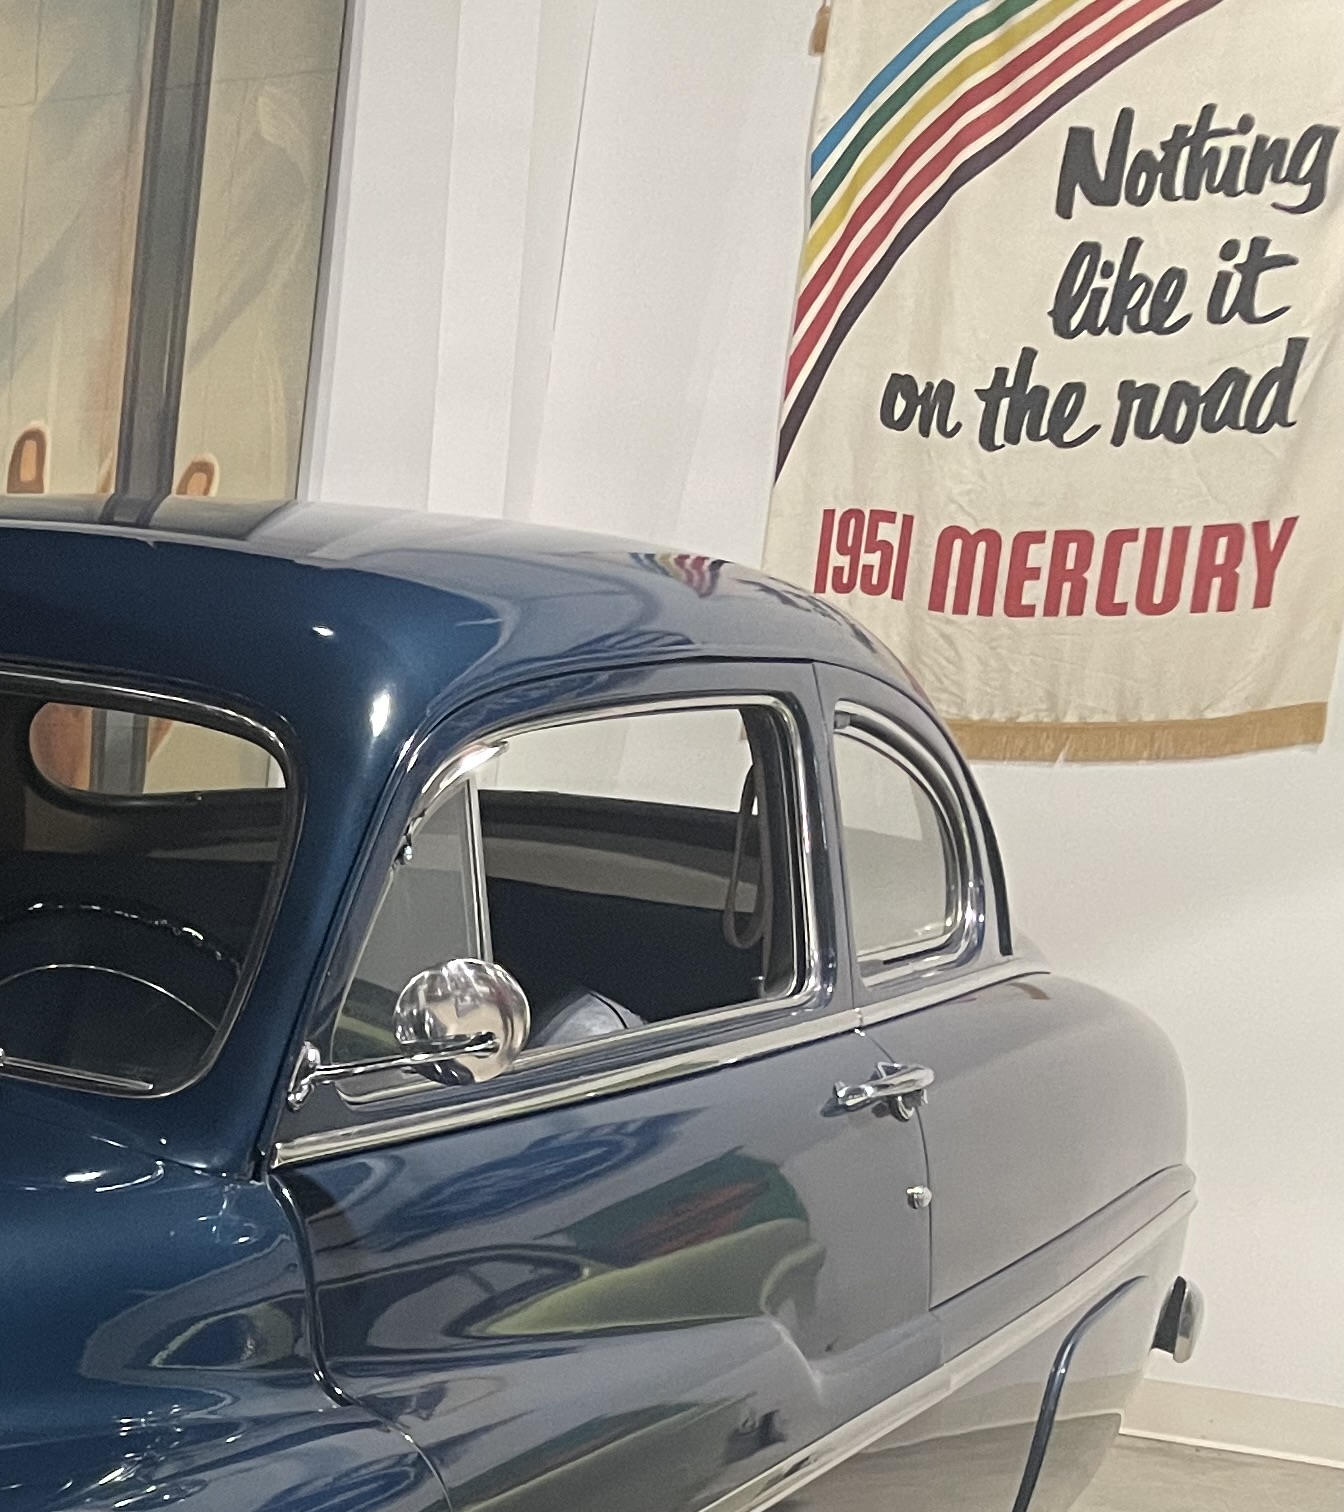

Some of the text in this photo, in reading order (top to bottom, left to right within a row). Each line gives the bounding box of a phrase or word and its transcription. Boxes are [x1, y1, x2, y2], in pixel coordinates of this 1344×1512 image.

[1055, 103, 1340, 218] Nothing
[1047, 235, 1299, 340] like it
[879, 337, 1310, 452] on the road
[814, 508, 1300, 618] 1951 MERCURY
